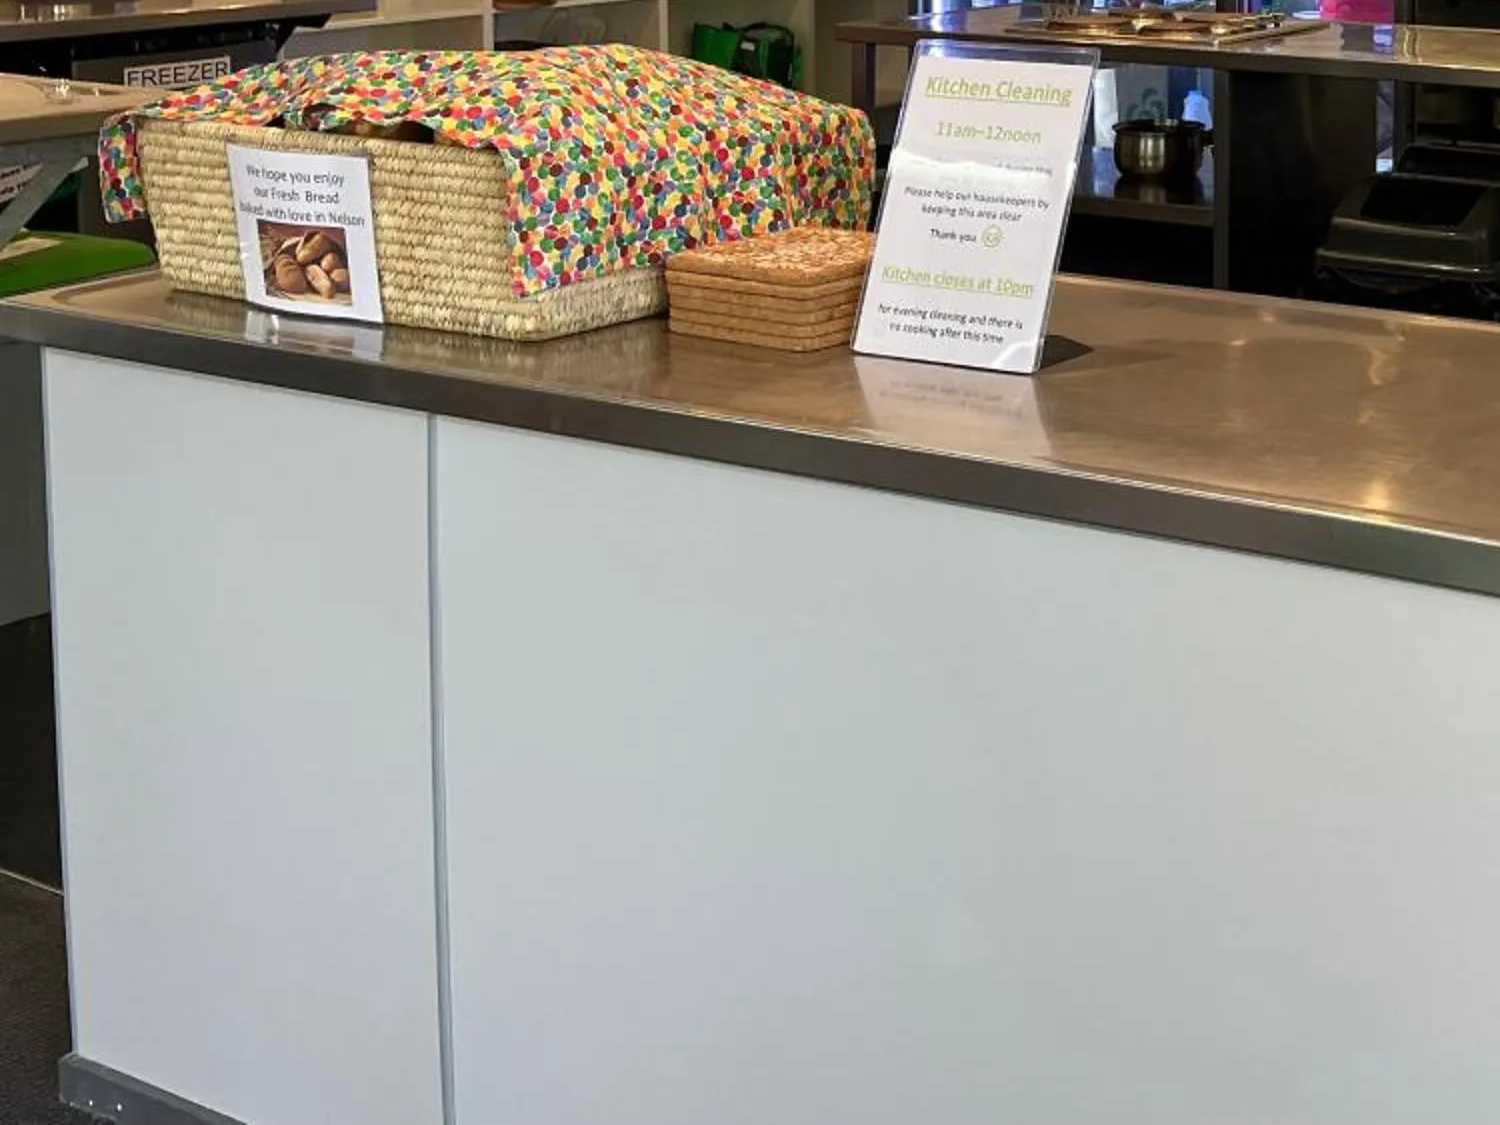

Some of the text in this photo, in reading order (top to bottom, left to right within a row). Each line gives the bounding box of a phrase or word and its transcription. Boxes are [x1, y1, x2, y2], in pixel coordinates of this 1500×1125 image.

[127, 60, 229, 87] FREEZER
[926, 75, 1073, 106] Kitchen Cleaning
[261, 166, 287, 182] hope
[290, 172, 311, 186] you
[313, 171, 344, 187] enjoy
[254, 187, 269, 198] our
[305, 190, 339, 204] Bread
[904, 186, 932, 198] Please
[934, 188, 952, 201] help
[955, 192, 971, 201] our
[1037, 198, 1050, 211] by
[266, 207, 287, 220] with
[287, 209, 312, 223] love
[314, 211, 326, 222] in
[329, 212, 365, 226] Nelson
[921, 202, 1023, 221] keeping this area clear
[930, 228, 977, 244] Thank you
[882, 265, 1034, 298] Kitchen closes at 10pm
[893, 307, 929, 321] evening
[929, 308, 967, 325] cleaning
[968, 314, 987, 326] and
[988, 316, 1012, 329] there
[1013, 320, 1023, 331] is
[902, 323, 938, 339] cooking
[939, 326, 962, 339] after
[963, 330, 981, 342] this
[983, 332, 1005, 344] time
